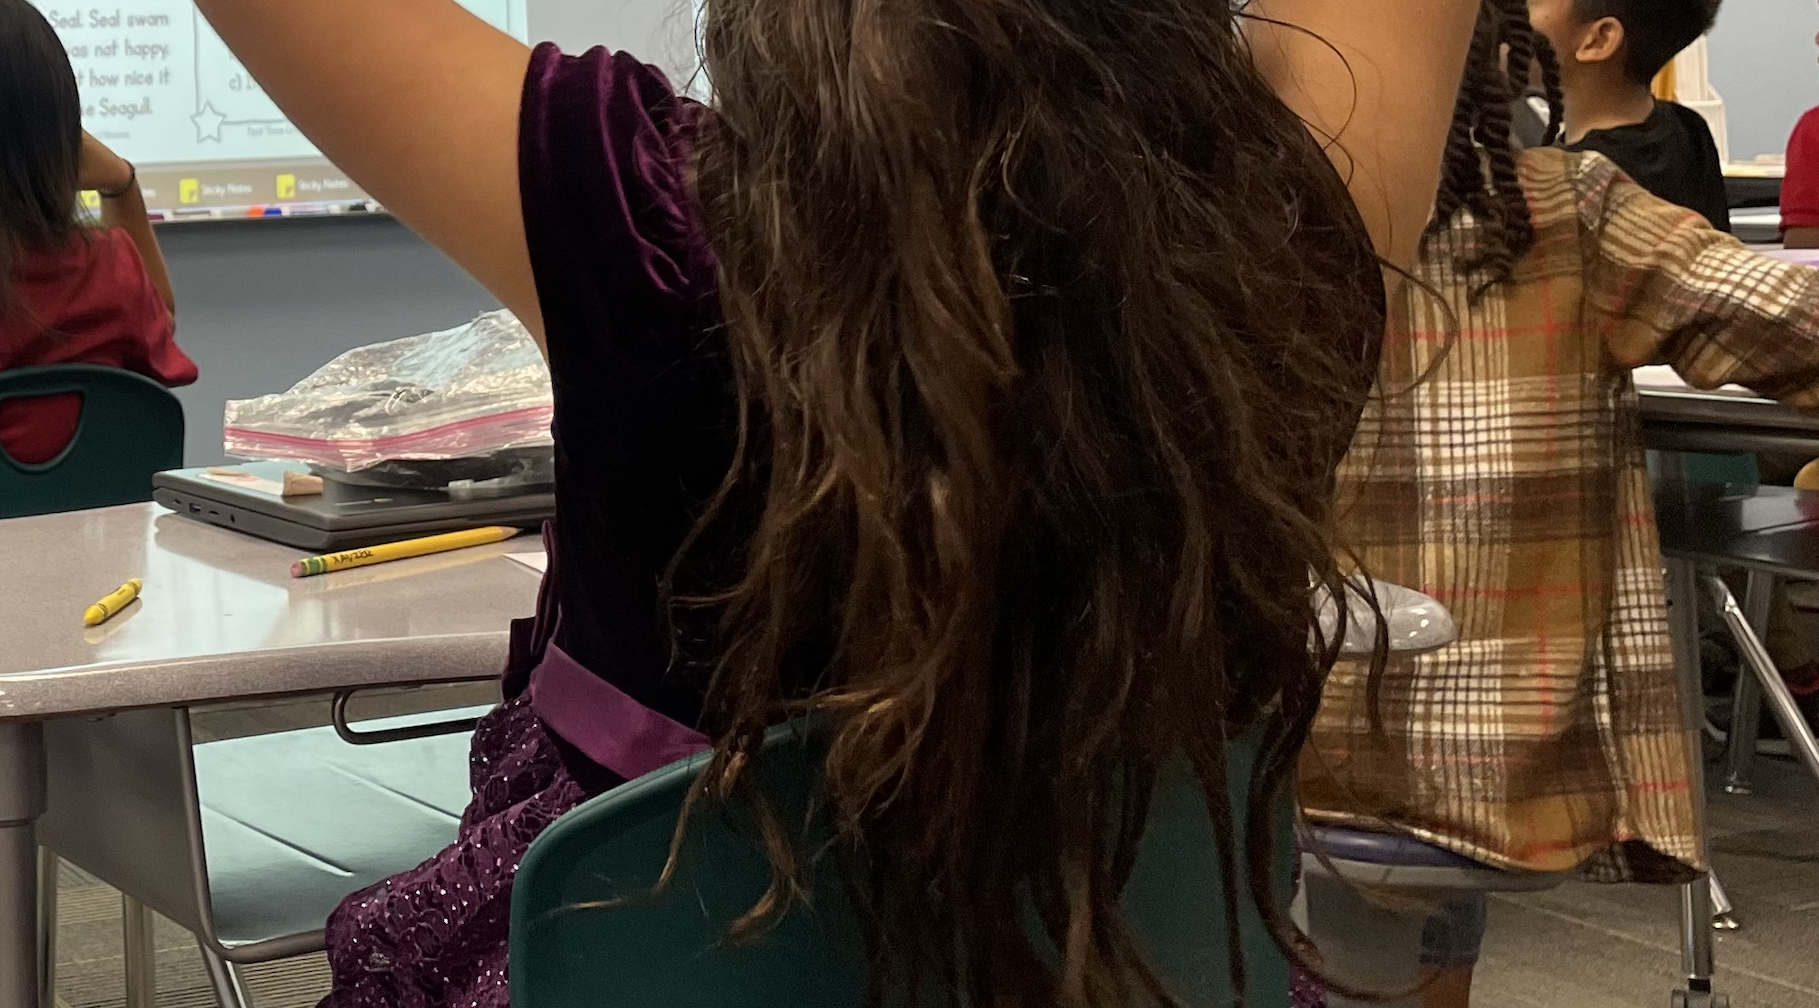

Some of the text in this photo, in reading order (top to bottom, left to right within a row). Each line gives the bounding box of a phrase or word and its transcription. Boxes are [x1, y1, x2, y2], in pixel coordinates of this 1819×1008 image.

[89, 9, 120, 29] Seal
[127, 13, 169, 28] swam
[94, 39, 170, 60] not happy.
[89, 69, 120, 86] how
[124, 72, 154, 86] nice
